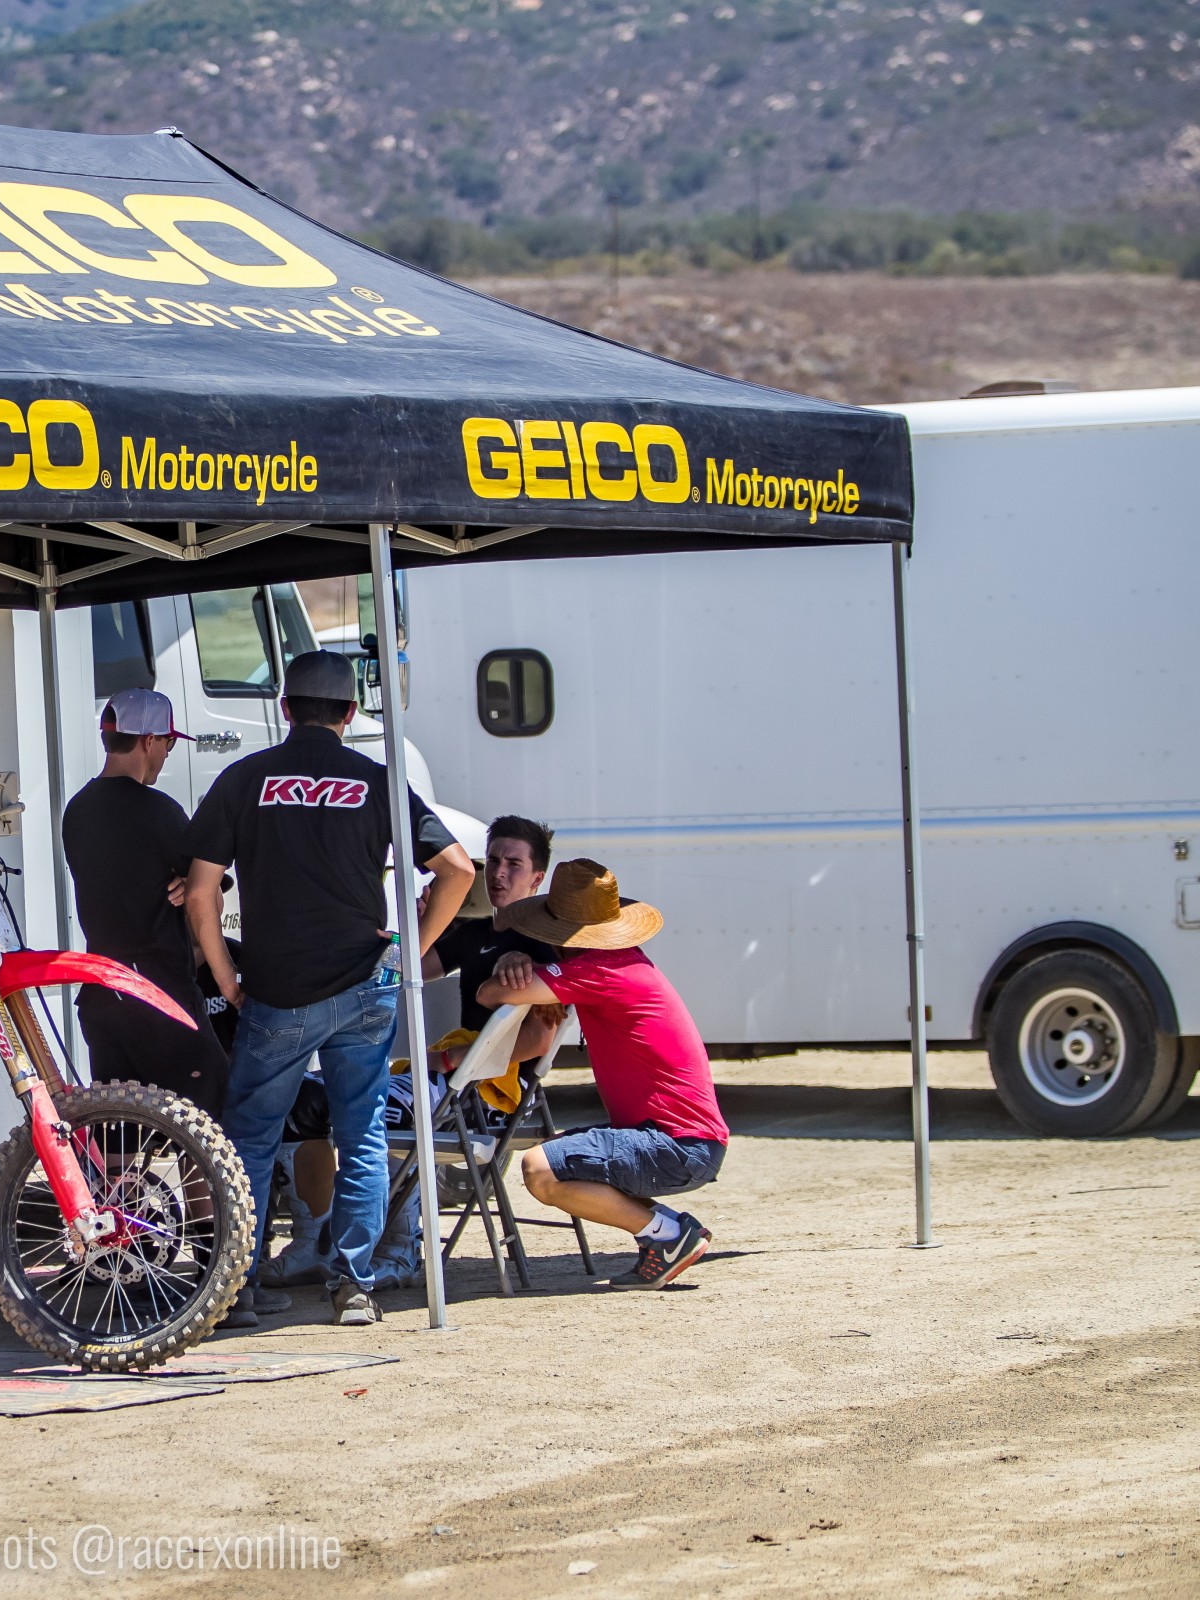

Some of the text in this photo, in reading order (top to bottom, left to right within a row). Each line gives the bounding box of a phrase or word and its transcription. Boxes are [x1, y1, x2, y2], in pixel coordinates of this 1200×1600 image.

[121, 436, 318, 506] Motorcycle
[461, 417, 860, 524] GEICO Motorcycle
[259, 775, 369, 808] KYB
